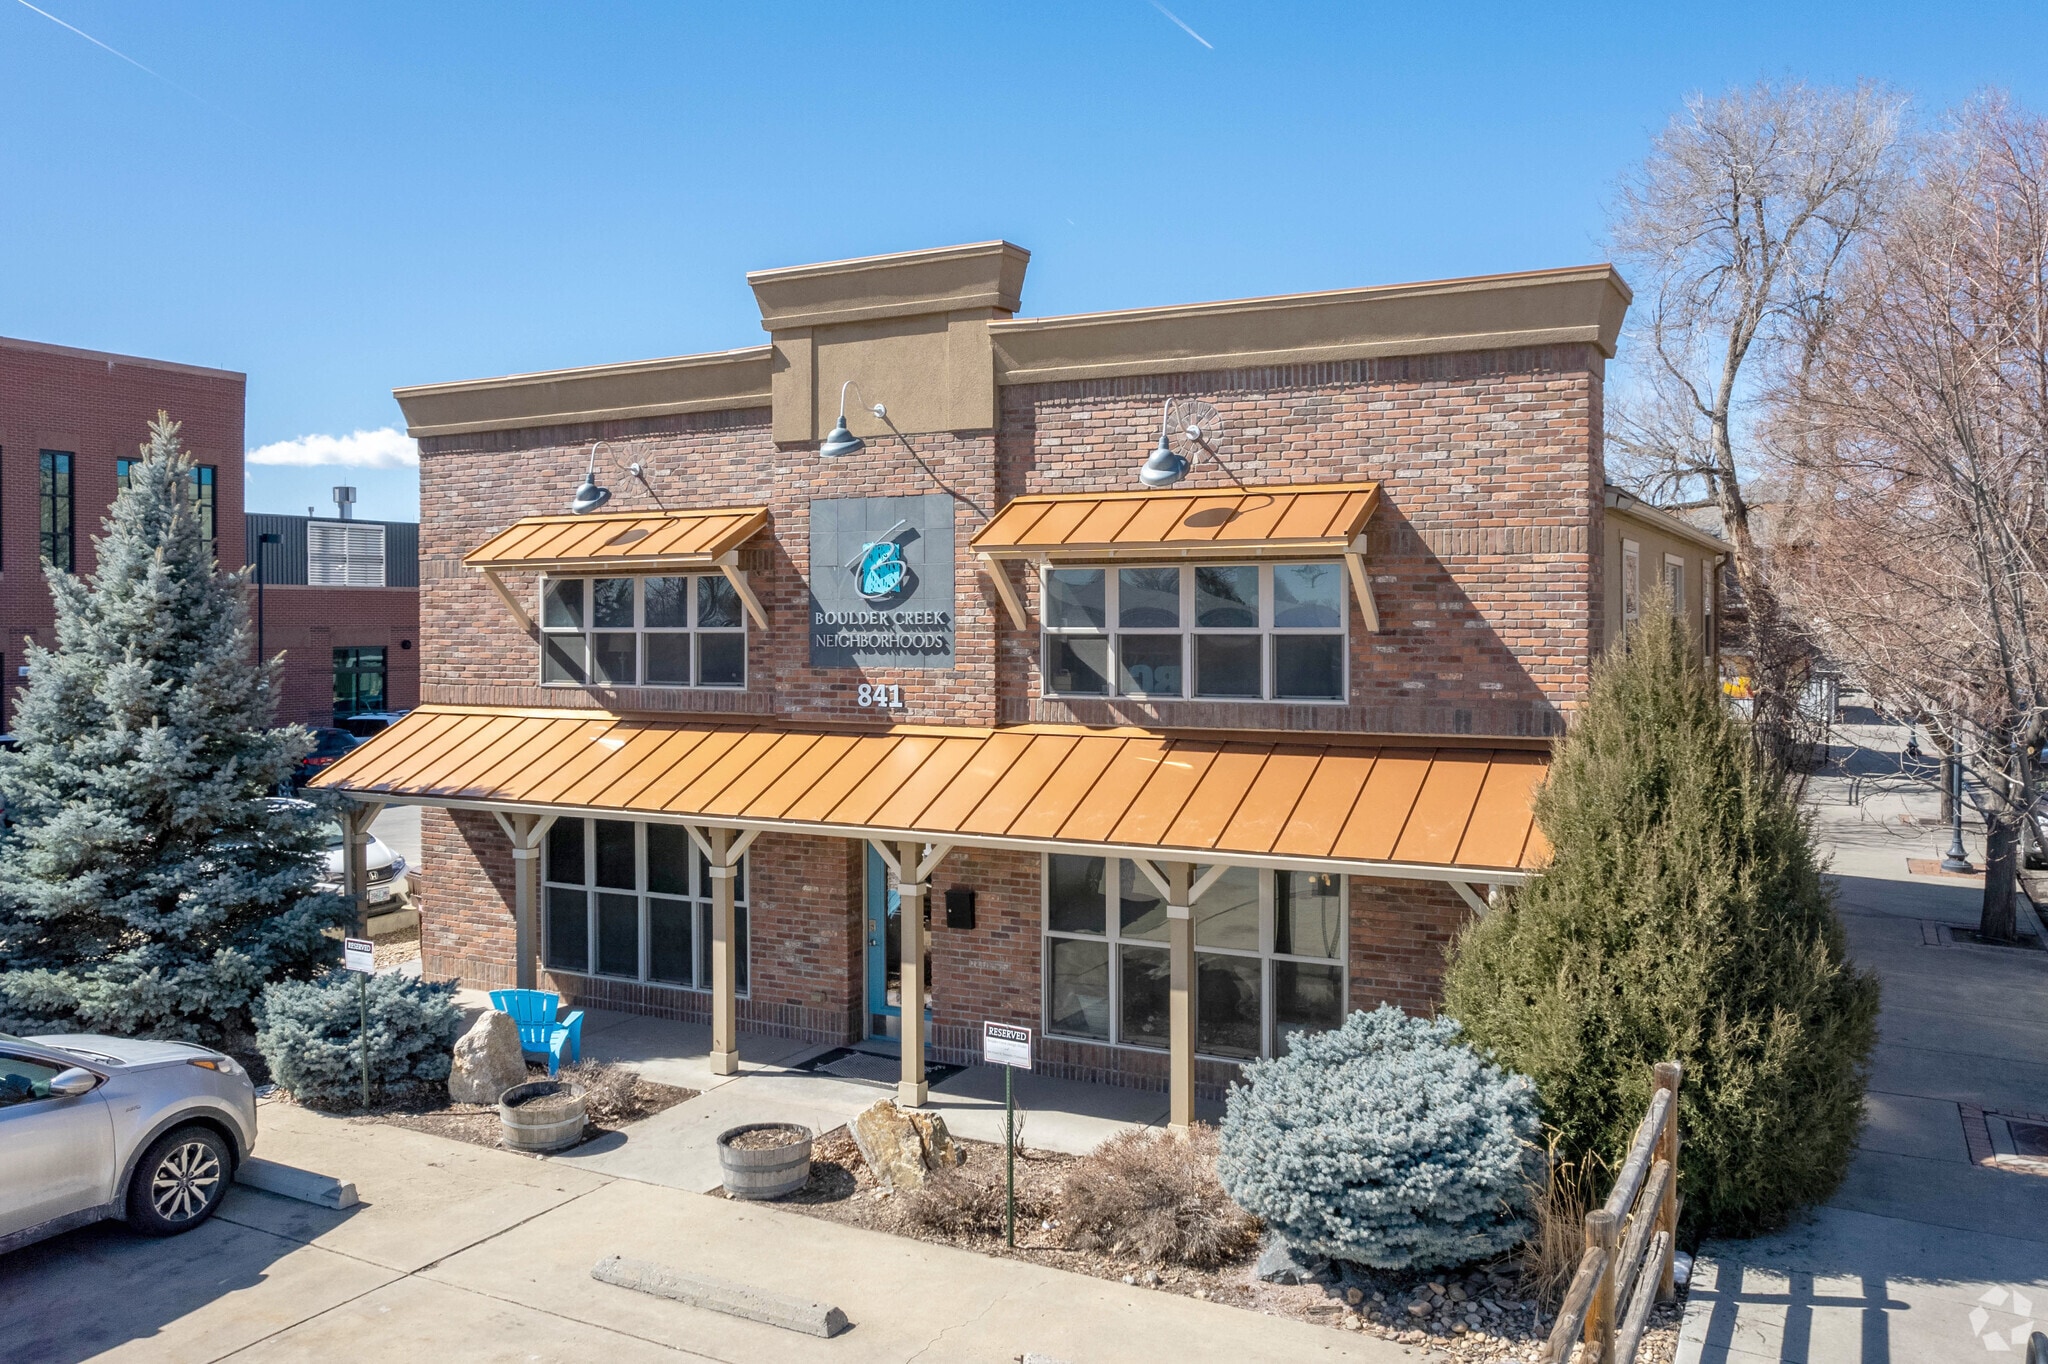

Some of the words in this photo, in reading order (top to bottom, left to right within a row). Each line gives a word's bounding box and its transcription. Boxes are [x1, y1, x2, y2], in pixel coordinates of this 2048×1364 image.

[815, 611, 889, 625] BOULDER
[894, 611, 946, 625] CREEK
[815, 634, 944, 648] NEIGHBORHOODS
[857, 683, 903, 708] 841
[988, 1027, 1026, 1040] RESERVED
